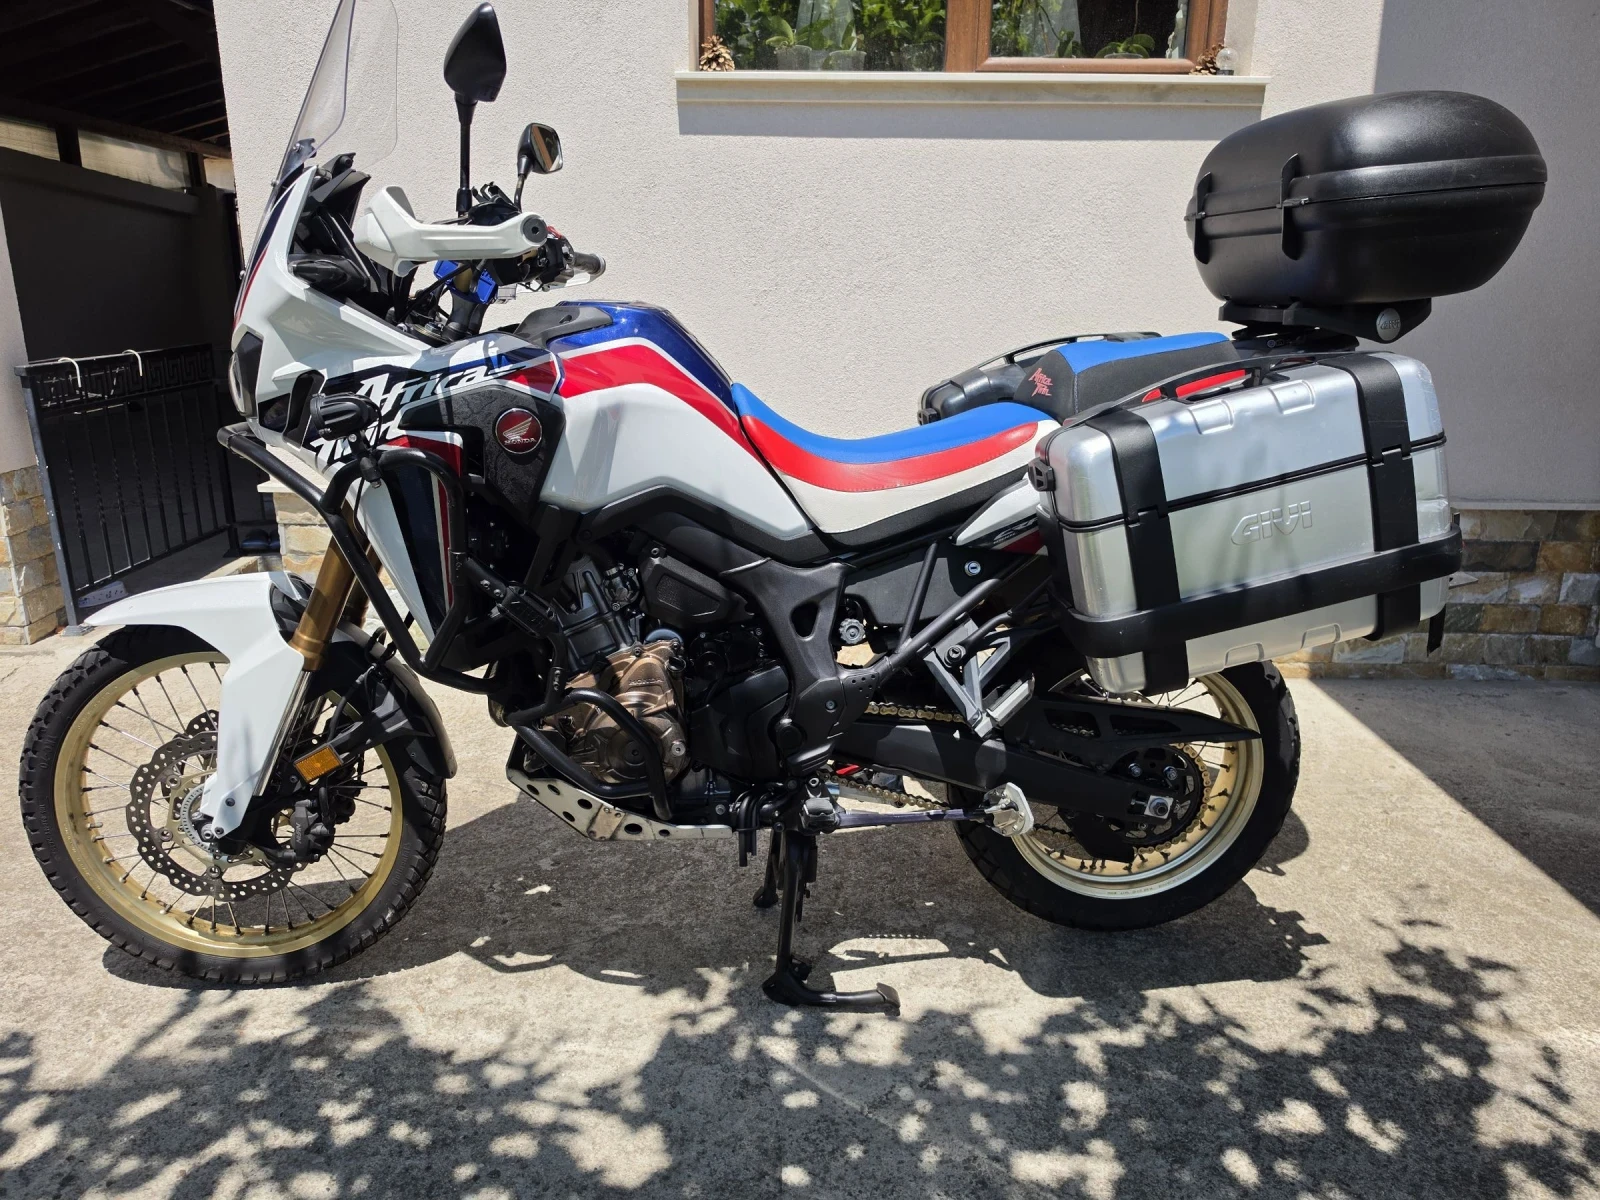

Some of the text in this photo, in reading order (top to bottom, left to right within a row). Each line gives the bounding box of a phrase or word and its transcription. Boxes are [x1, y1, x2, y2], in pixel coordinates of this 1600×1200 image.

[356, 363, 512, 417] Africa
[504, 437, 537, 446] HONDA
[1231, 500, 1313, 546] GIVI
